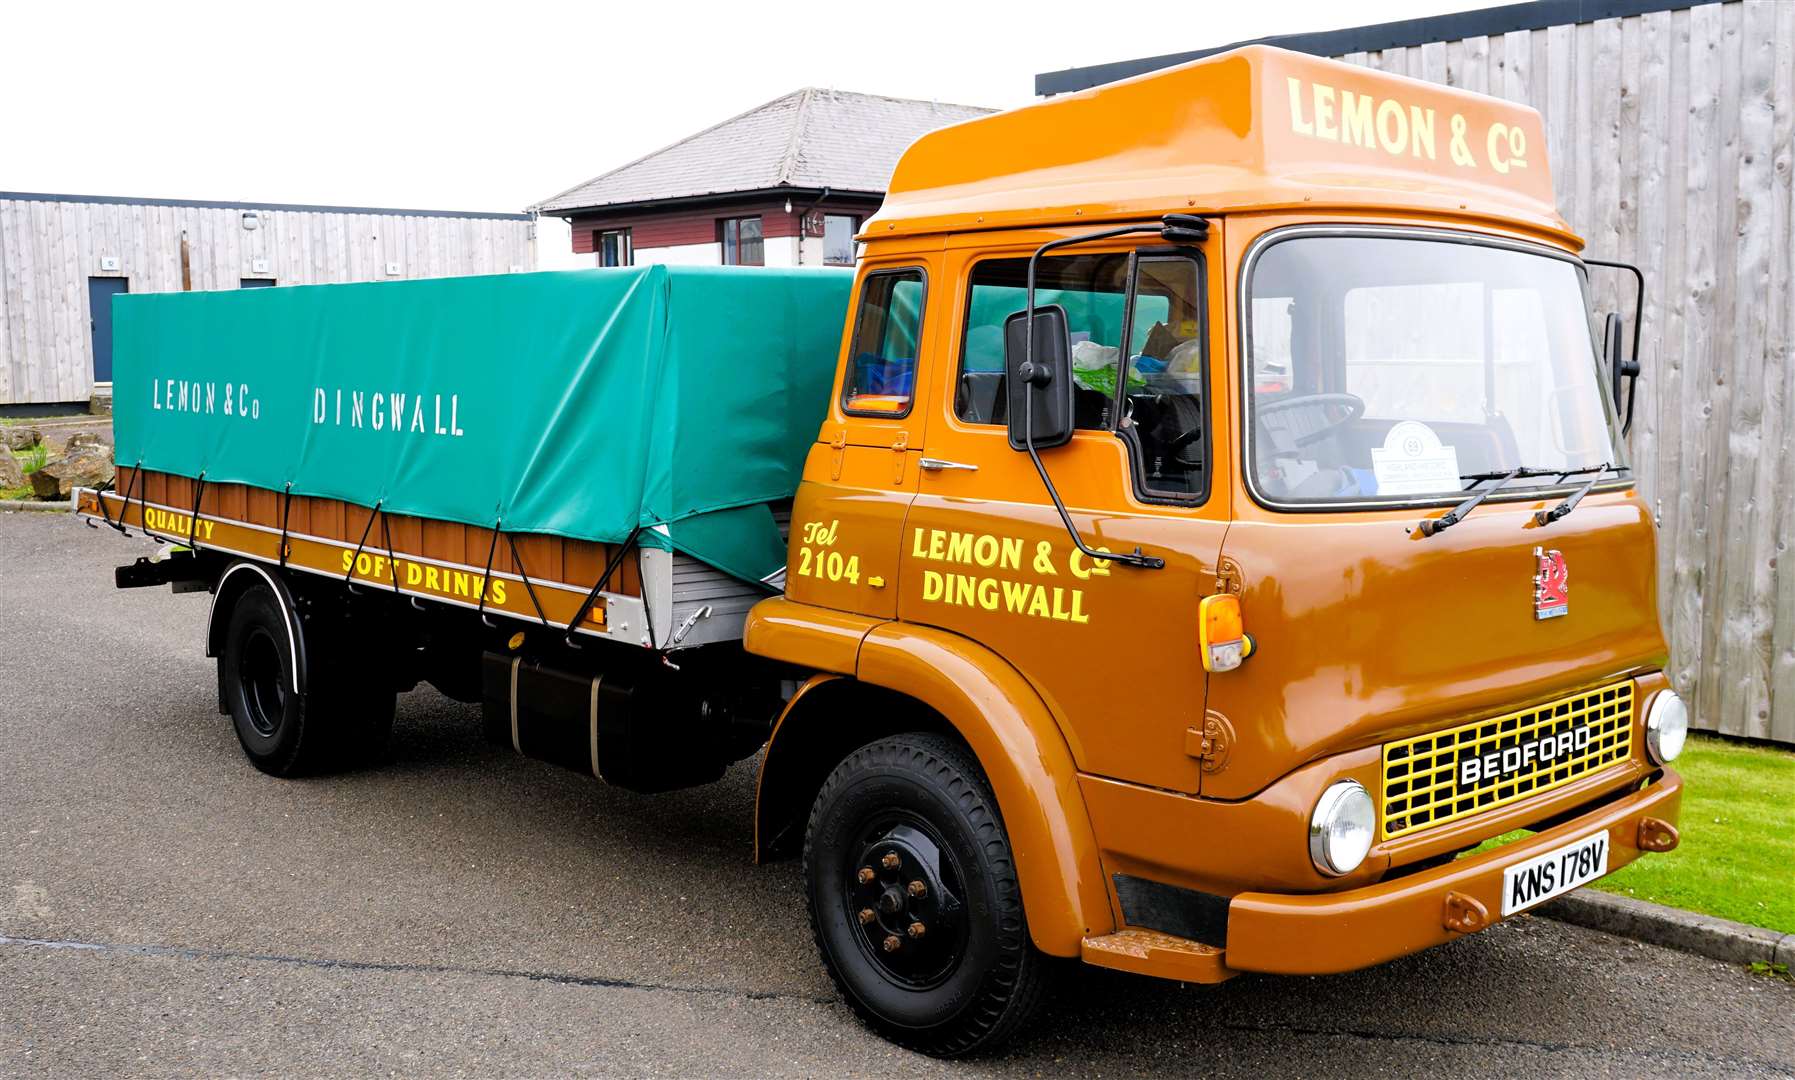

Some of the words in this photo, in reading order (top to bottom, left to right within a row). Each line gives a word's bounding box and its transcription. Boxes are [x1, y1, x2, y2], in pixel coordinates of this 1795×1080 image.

[1287, 77, 1436, 160] LEMON
[1450, 113, 1477, 168] &
[153, 379, 215, 414] LEMON
[314, 387, 464, 436] DINGWALL
[145, 507, 215, 539] QUALITY
[803, 520, 840, 546] Tel
[798, 547, 860, 585] 2104
[912, 527, 1024, 570] LEMON
[1033, 540, 1058, 575] &
[342, 550, 399, 581] SOFT
[407, 562, 506, 604] DRINKS
[922, 570, 1090, 625] DINGWALL
[1461, 725, 1590, 785] BEDFORD
[1512, 860, 1555, 907] KNS
[1560, 839, 1604, 888] 178V
